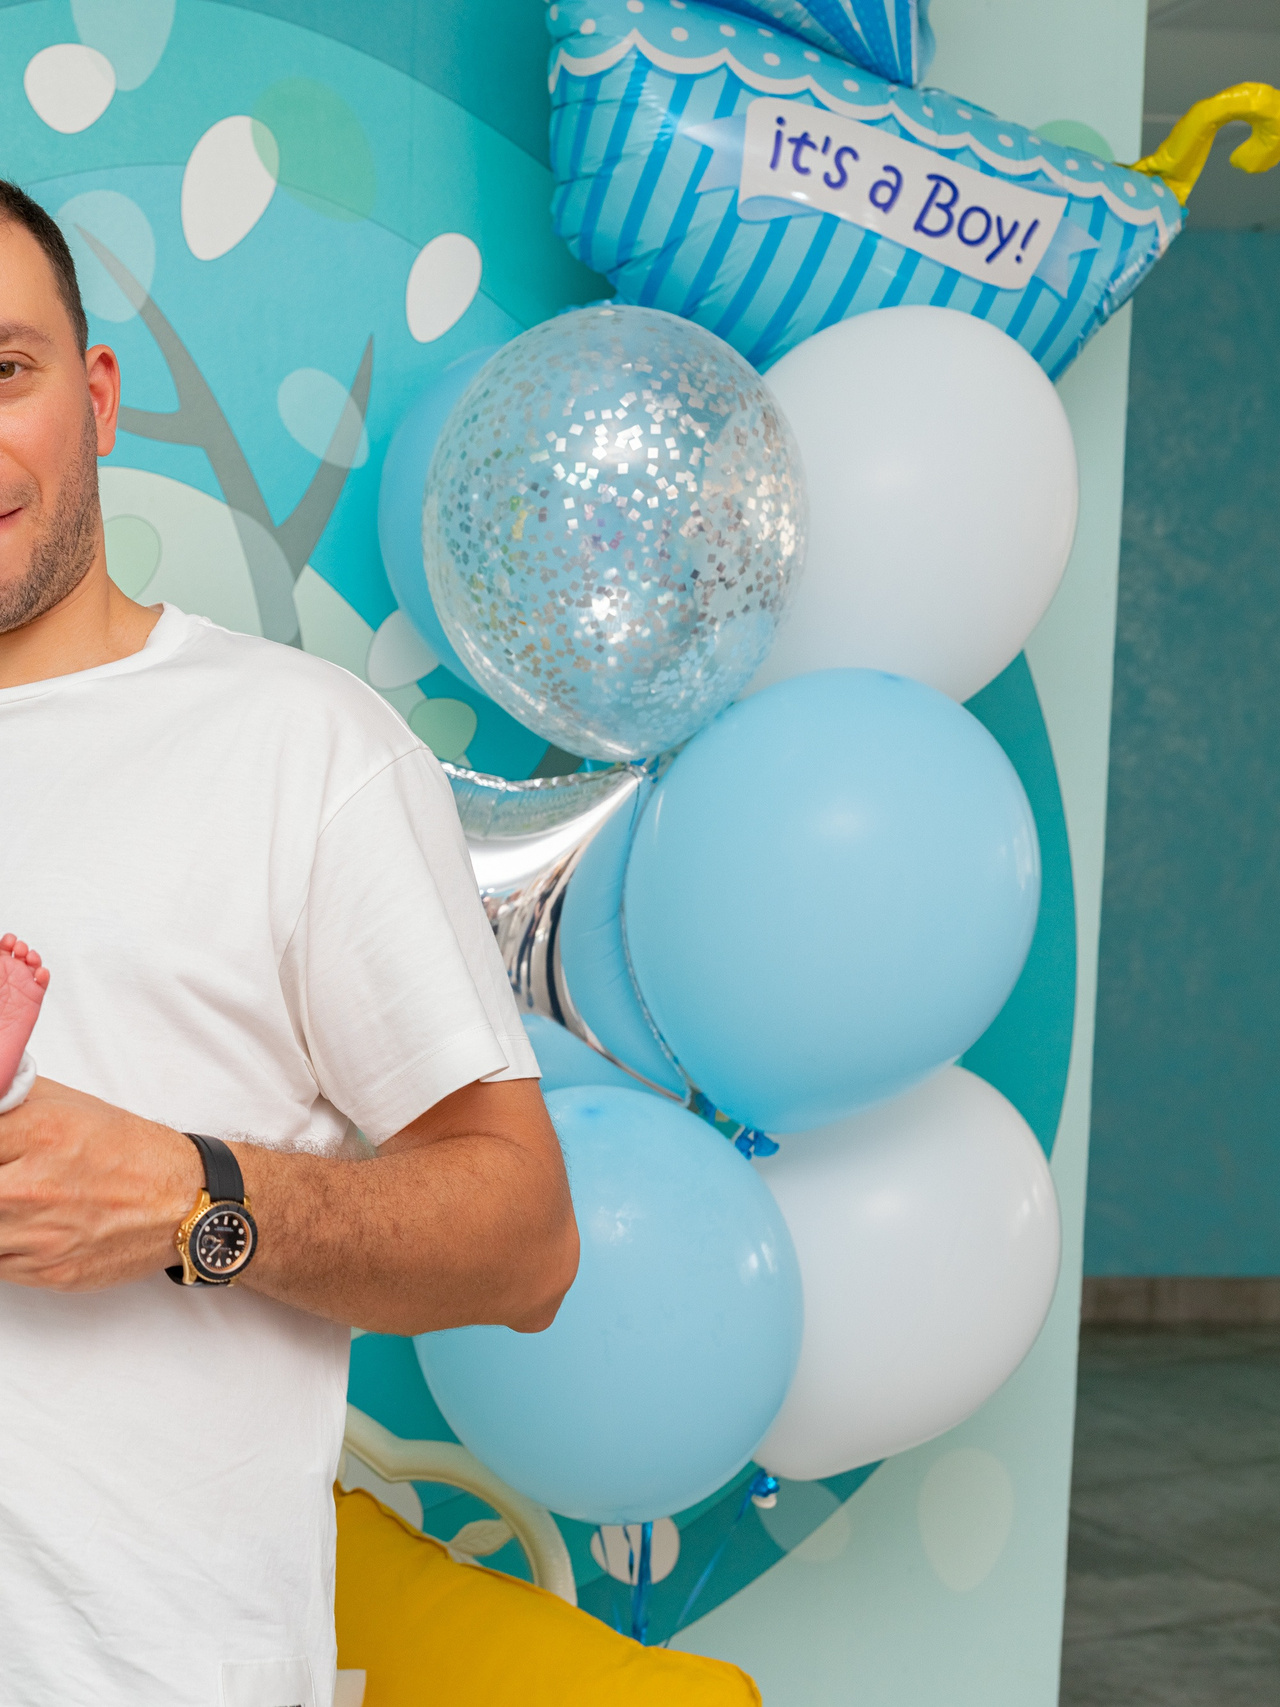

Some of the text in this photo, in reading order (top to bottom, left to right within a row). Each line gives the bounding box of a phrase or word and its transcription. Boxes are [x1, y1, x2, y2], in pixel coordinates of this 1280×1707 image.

[769, 116, 1041, 265] it's a Boy!
